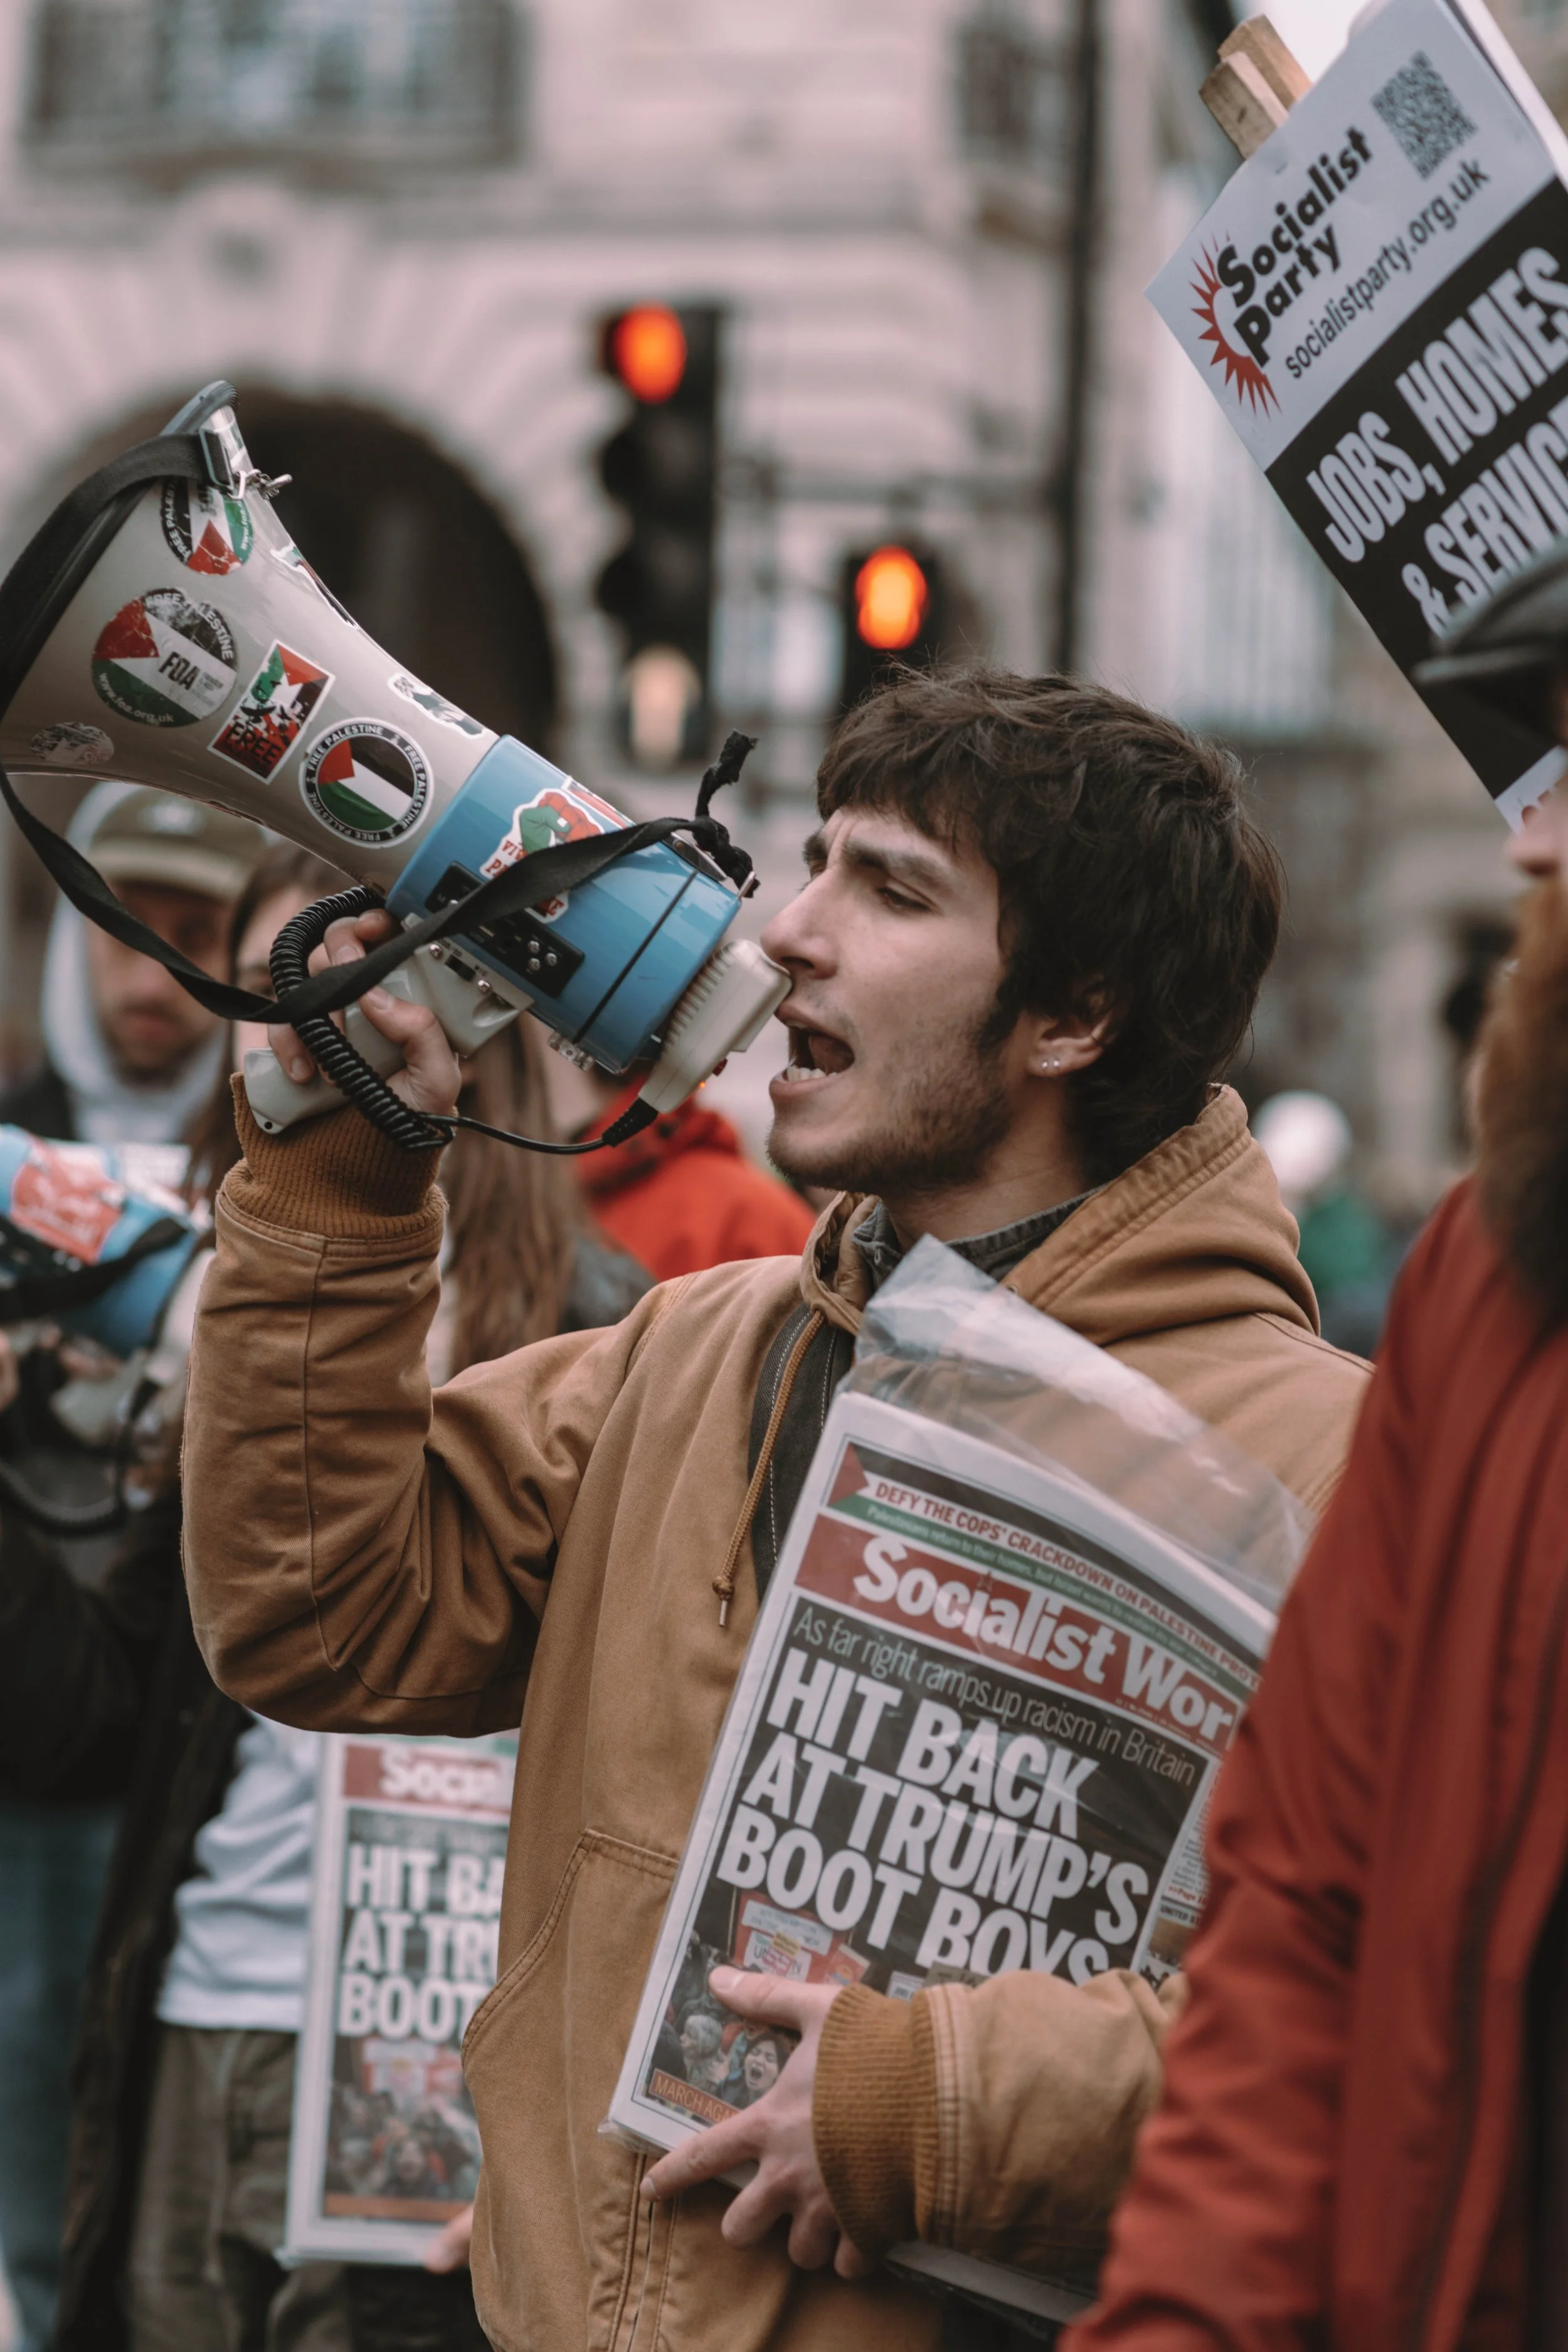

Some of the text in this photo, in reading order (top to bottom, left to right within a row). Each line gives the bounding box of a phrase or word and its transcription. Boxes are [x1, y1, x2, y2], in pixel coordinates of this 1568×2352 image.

[1217, 126, 1372, 308] Socialist
[1285, 157, 1491, 379] socialistparty.org.uk
[1233, 223, 1342, 368] Party
[1306, 246, 1568, 563] JOBS, HOMES
[158, 651, 201, 691] FOA
[1401, 563, 1455, 639] &
[226, 720, 282, 765] FREE
[308, 724, 384, 770] FREE PALESTINE
[401, 744, 427, 829] FREE PALESTINE
[355, 831, 381, 841] FREE
[853, 1534, 1116, 1684] Socialist
[875, 1482, 921, 1510] DEFY
[921, 1498, 955, 1524] THE
[956, 1511, 1007, 1542] COPS'
[1007, 1530, 1113, 1591] CRACKDOWN
[1115, 1584, 1140, 1606] ON
[1138, 1596, 1219, 1661] PALESTINE
[766, 1647, 903, 1762] HIT
[896, 1697, 1100, 1840] BACK
[793, 1606, 826, 1646] As
[827, 1618, 862, 1658] far
[861, 1634, 918, 1682] right
[916, 1658, 991, 1708] ramps
[991, 1686, 1022, 1724] up
[1022, 1697, 1097, 1747] racism
[1096, 1718, 1121, 1755] in
[1121, 1728, 1196, 1787] Britain
[347, 1843, 436, 1911] HIT
[716, 1804, 923, 1950] BOOT
[741, 1732, 847, 1830] AT
[847, 1765, 1149, 1945] TRUMP'S
[344, 1909, 415, 1976] AT
[654, 2074, 704, 2113] MARCH
